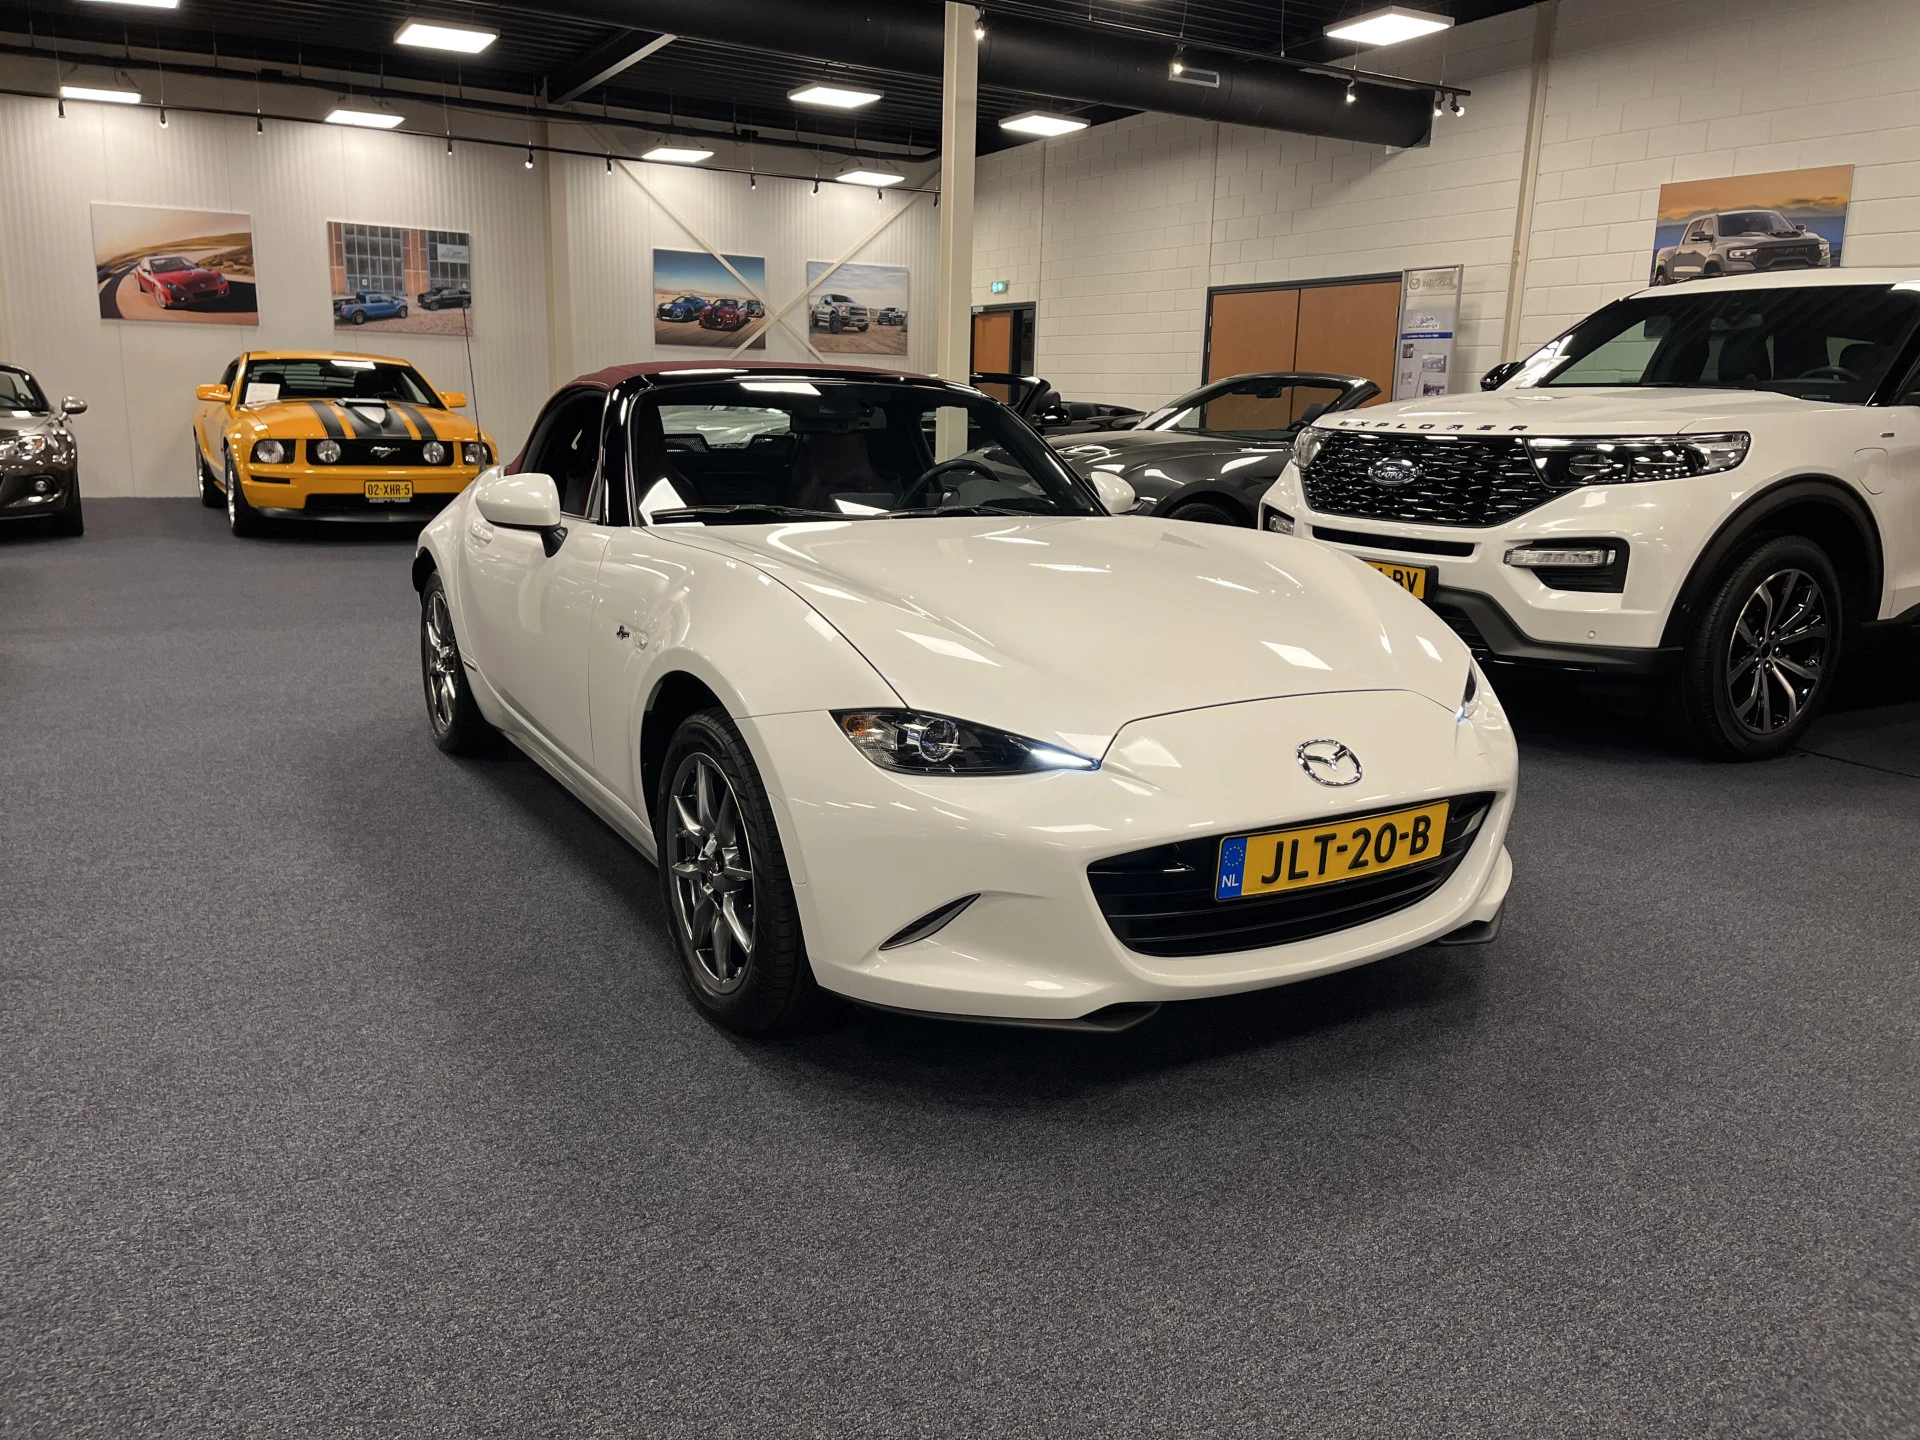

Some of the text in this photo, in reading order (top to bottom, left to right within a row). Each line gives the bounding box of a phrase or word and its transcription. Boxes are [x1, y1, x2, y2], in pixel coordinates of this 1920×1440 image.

[1338, 420, 1529, 432] EXPLORER
[367, 484, 410, 496] 02-XHR-5
[1261, 814, 1432, 884] JLT-20-B
[1221, 874, 1240, 888] NL
